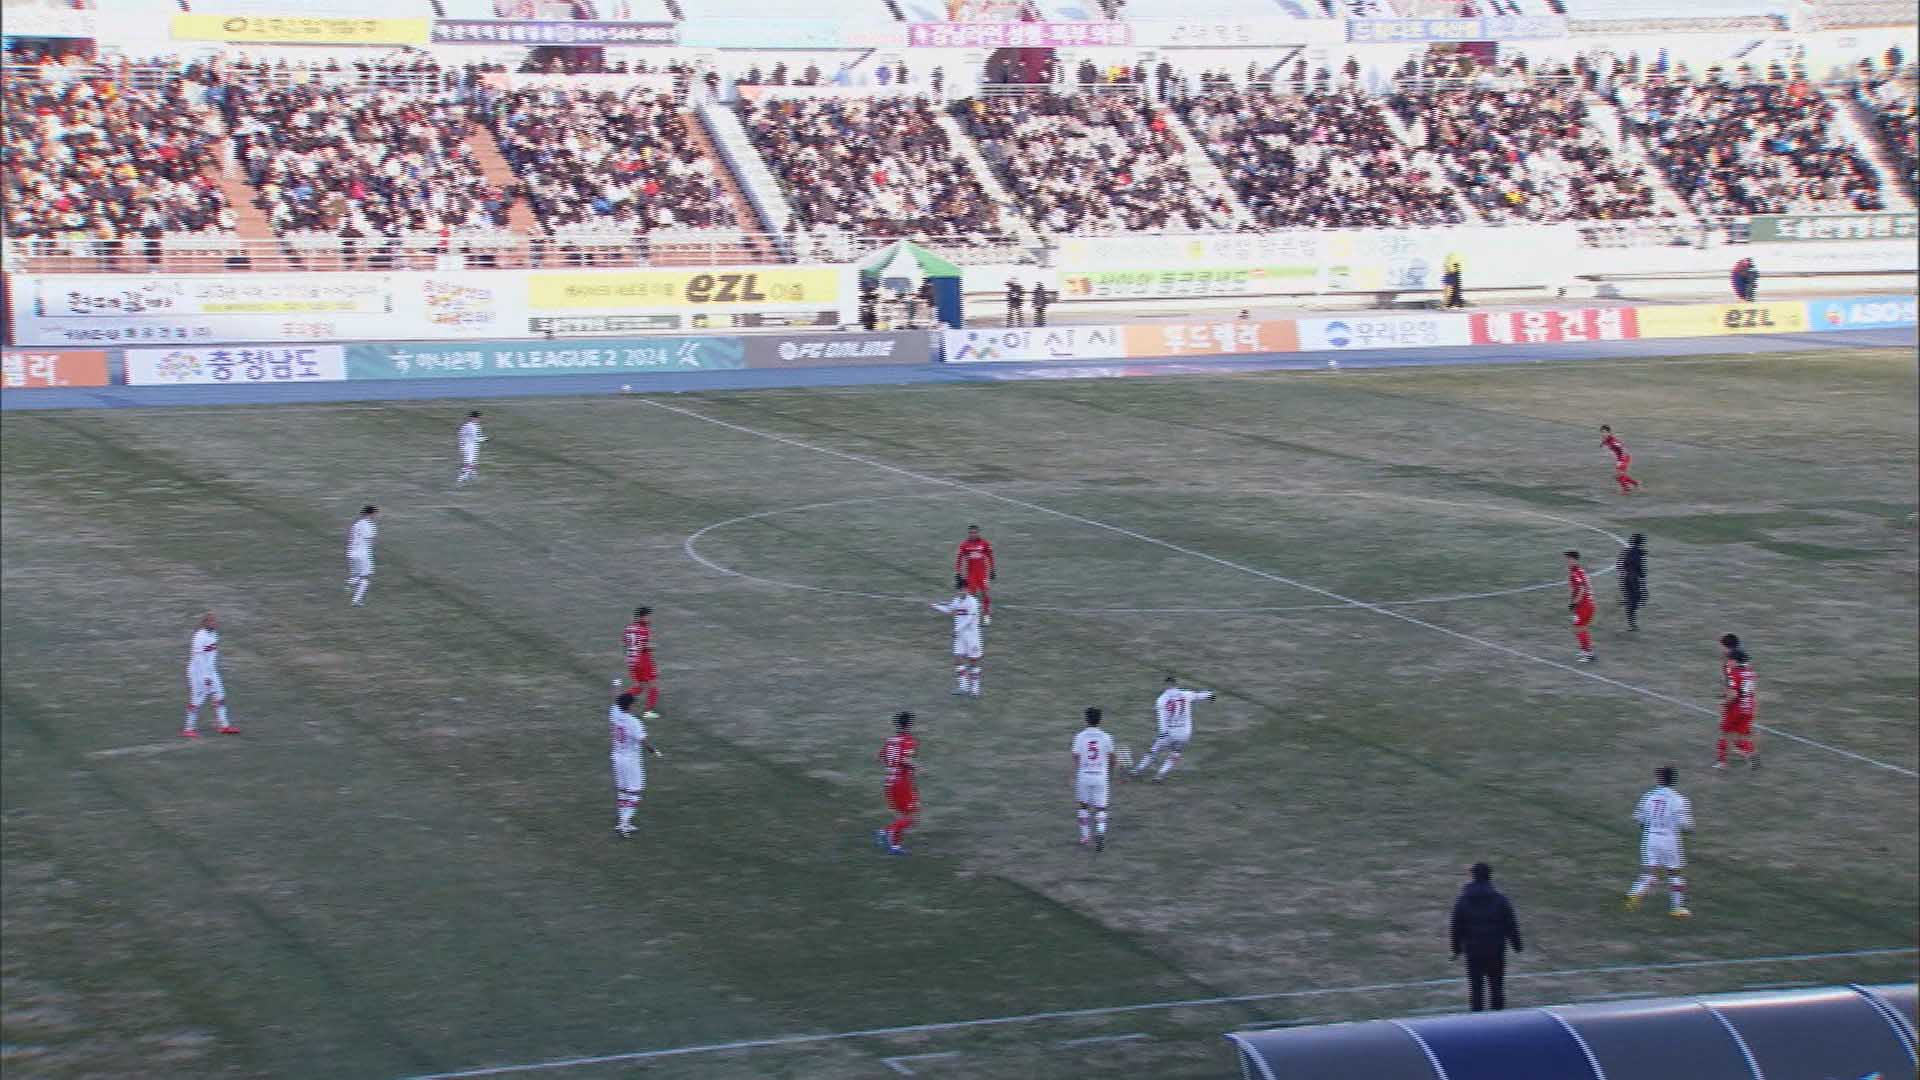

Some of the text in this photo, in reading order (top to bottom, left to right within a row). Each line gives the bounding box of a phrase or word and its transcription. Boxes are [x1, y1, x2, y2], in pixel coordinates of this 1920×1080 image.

[1002, 328, 1119, 357] 아산시
[1356, 321, 1438, 345] 우리은행
[495, 347, 668, 370] K LEAGUE 2 2024
[799, 340, 896, 359] FC ONLINE
[207, 348, 322, 381] 충청남도
[415, 351, 485, 370] 하나은행
[1165, 698, 1186, 718] 97
[1087, 740, 1100, 760] 5
